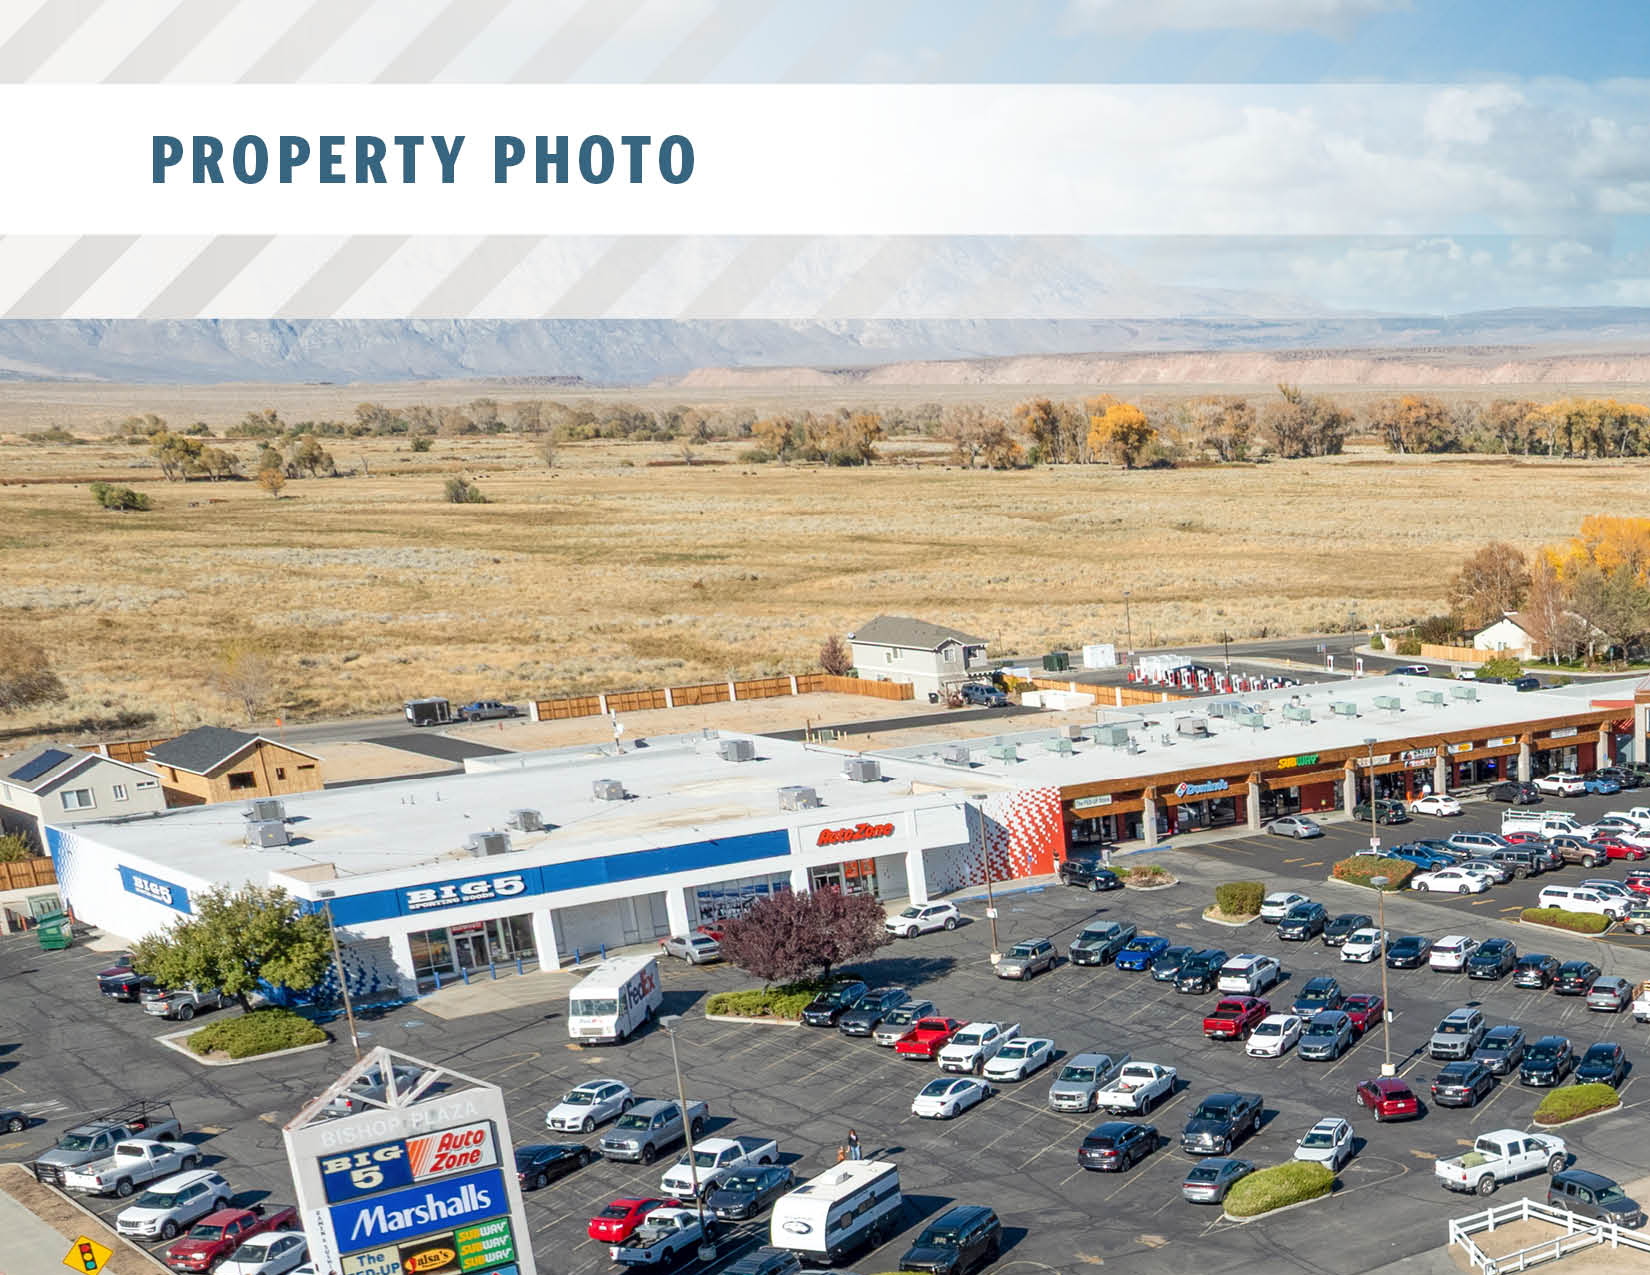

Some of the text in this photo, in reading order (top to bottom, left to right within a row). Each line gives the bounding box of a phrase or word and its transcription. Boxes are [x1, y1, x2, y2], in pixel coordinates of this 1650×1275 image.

[1278, 753, 1319, 769] SUBWAY
[816, 822, 895, 847] AutoZone
[406, 875, 526, 904] BIG 5
[319, 1100, 479, 1148] BISHOP PLAZA
[437, 1128, 487, 1153] Auto
[321, 1145, 405, 1175] BIG
[429, 1148, 482, 1173] Zone
[350, 1165, 385, 1189] 5
[350, 1183, 492, 1241] Marshalls
[457, 1221, 508, 1243] SUBWAY
[460, 1235, 511, 1256] SUBWAY
[356, 1252, 385, 1268] The
[463, 1248, 513, 1270] SUBWAY
